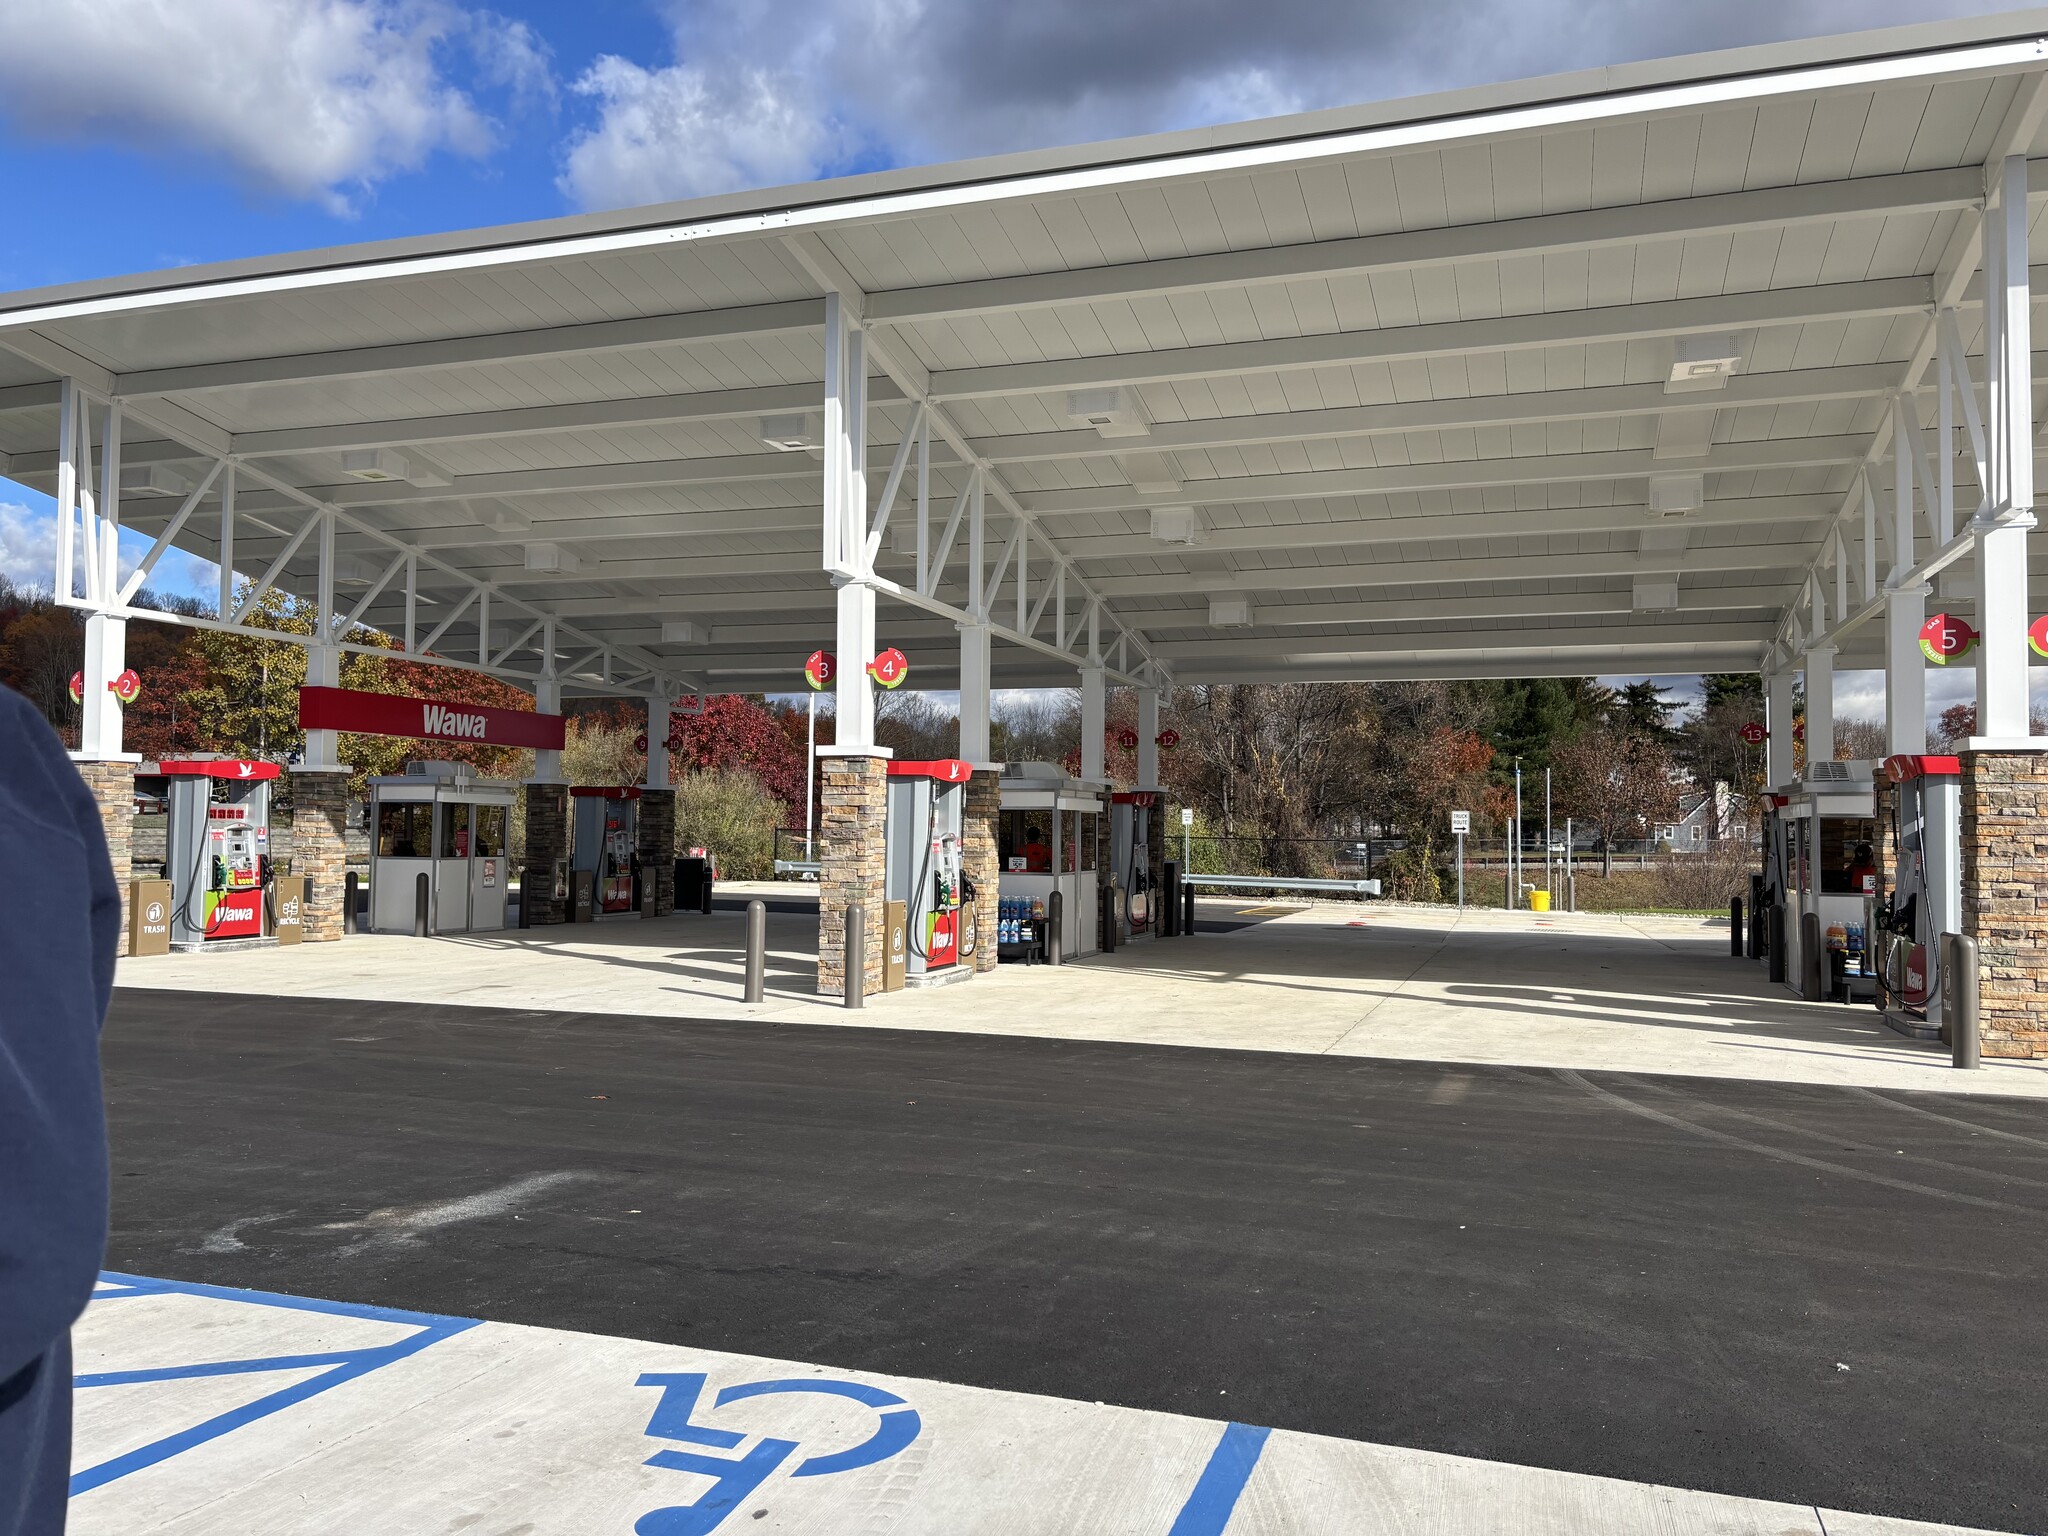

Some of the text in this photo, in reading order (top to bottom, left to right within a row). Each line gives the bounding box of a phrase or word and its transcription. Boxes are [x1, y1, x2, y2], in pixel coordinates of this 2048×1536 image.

[1927, 618, 1940, 630] GAS
[1941, 629, 1957, 649] 5
[894, 651, 902, 661] GAS
[1923, 643, 1943, 661] DIESEL
[818, 662, 829, 678] 3
[882, 660, 895, 677] 4
[79, 681, 84, 695] 1
[122, 679, 131, 693] 2
[423, 704, 486, 739] Wawa
[1123, 736, 1134, 746] 11
[1162, 735, 1174, 746] 12
[1747, 729, 1762, 741] 13
[639, 741, 646, 750] 9
[669, 740, 680, 749] 10
[215, 906, 253, 923] Wawa
[143, 925, 166, 934] TRASH
[1906, 966, 1923, 991] Wawa
